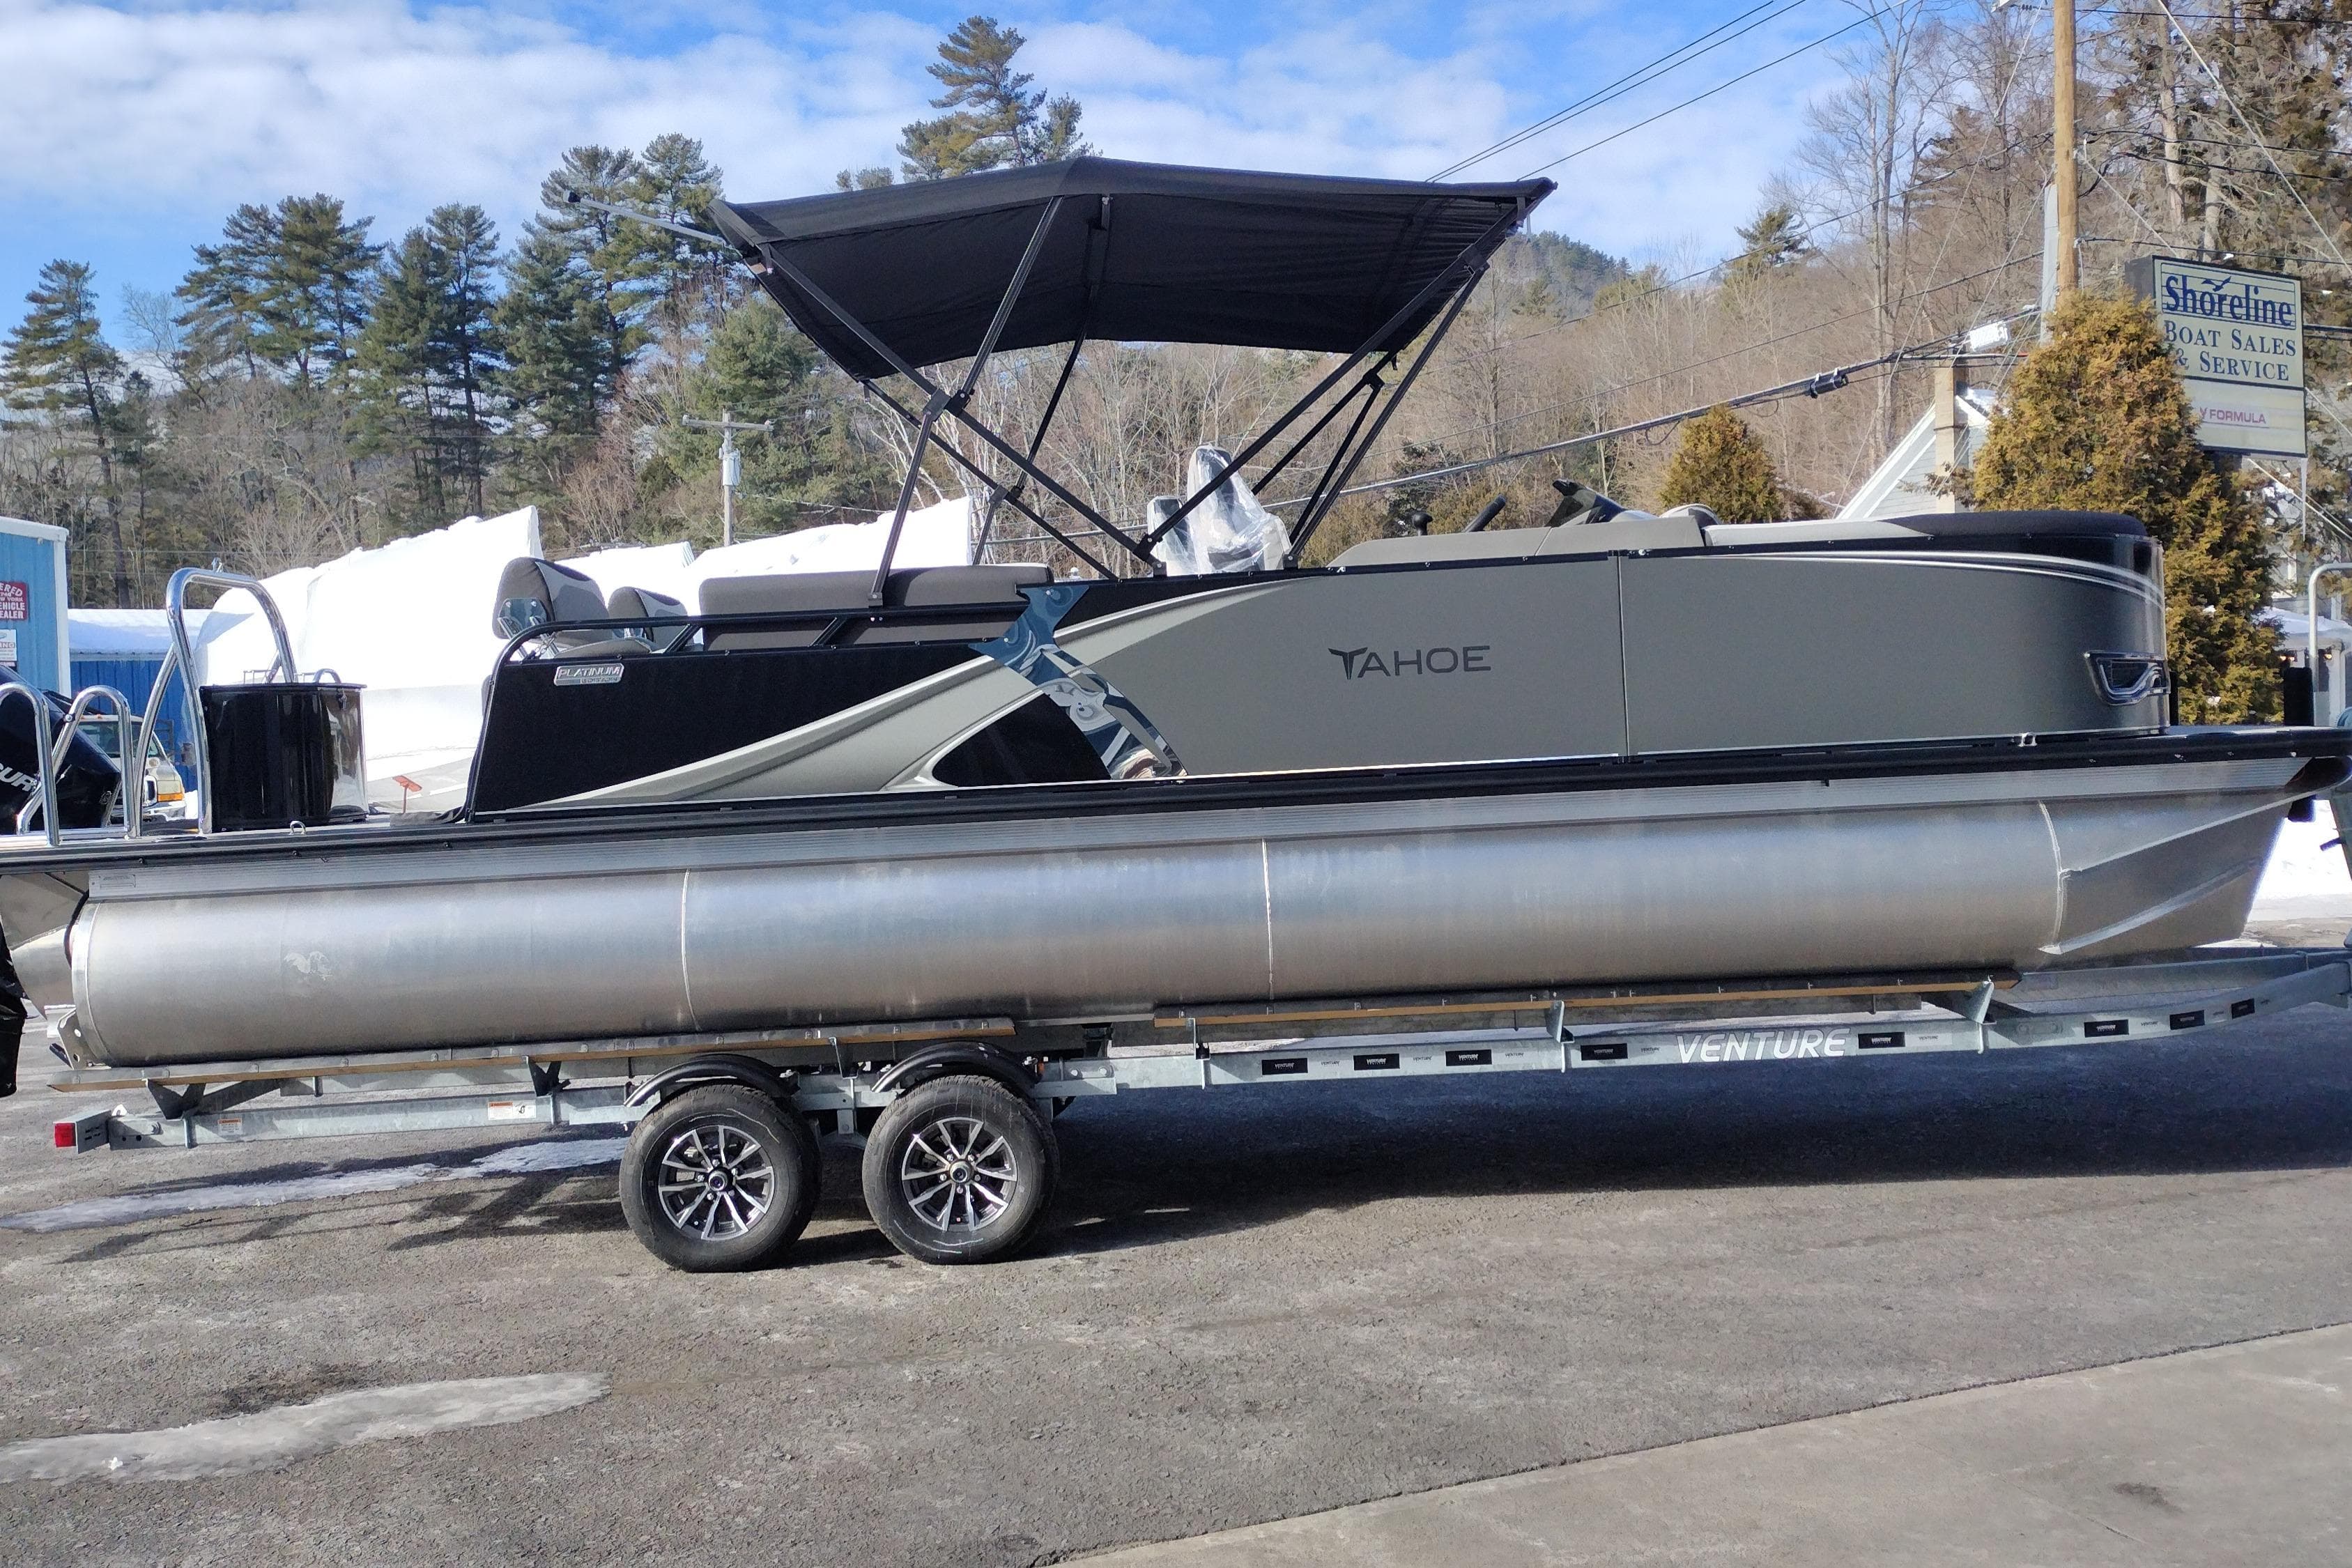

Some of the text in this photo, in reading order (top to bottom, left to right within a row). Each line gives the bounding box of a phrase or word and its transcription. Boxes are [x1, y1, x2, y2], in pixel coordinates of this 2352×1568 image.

[2166, 275, 2293, 326] Shoreline
[2164, 320, 2296, 357] BOAT SALES
[2199, 351, 2289, 381] SERVICE
[2209, 408, 2266, 424] FORMULA
[558, 666, 620, 678] PLATINUM
[1328, 645, 1491, 680] TAHOE
[1676, 1027, 1850, 1063] VENTURE
